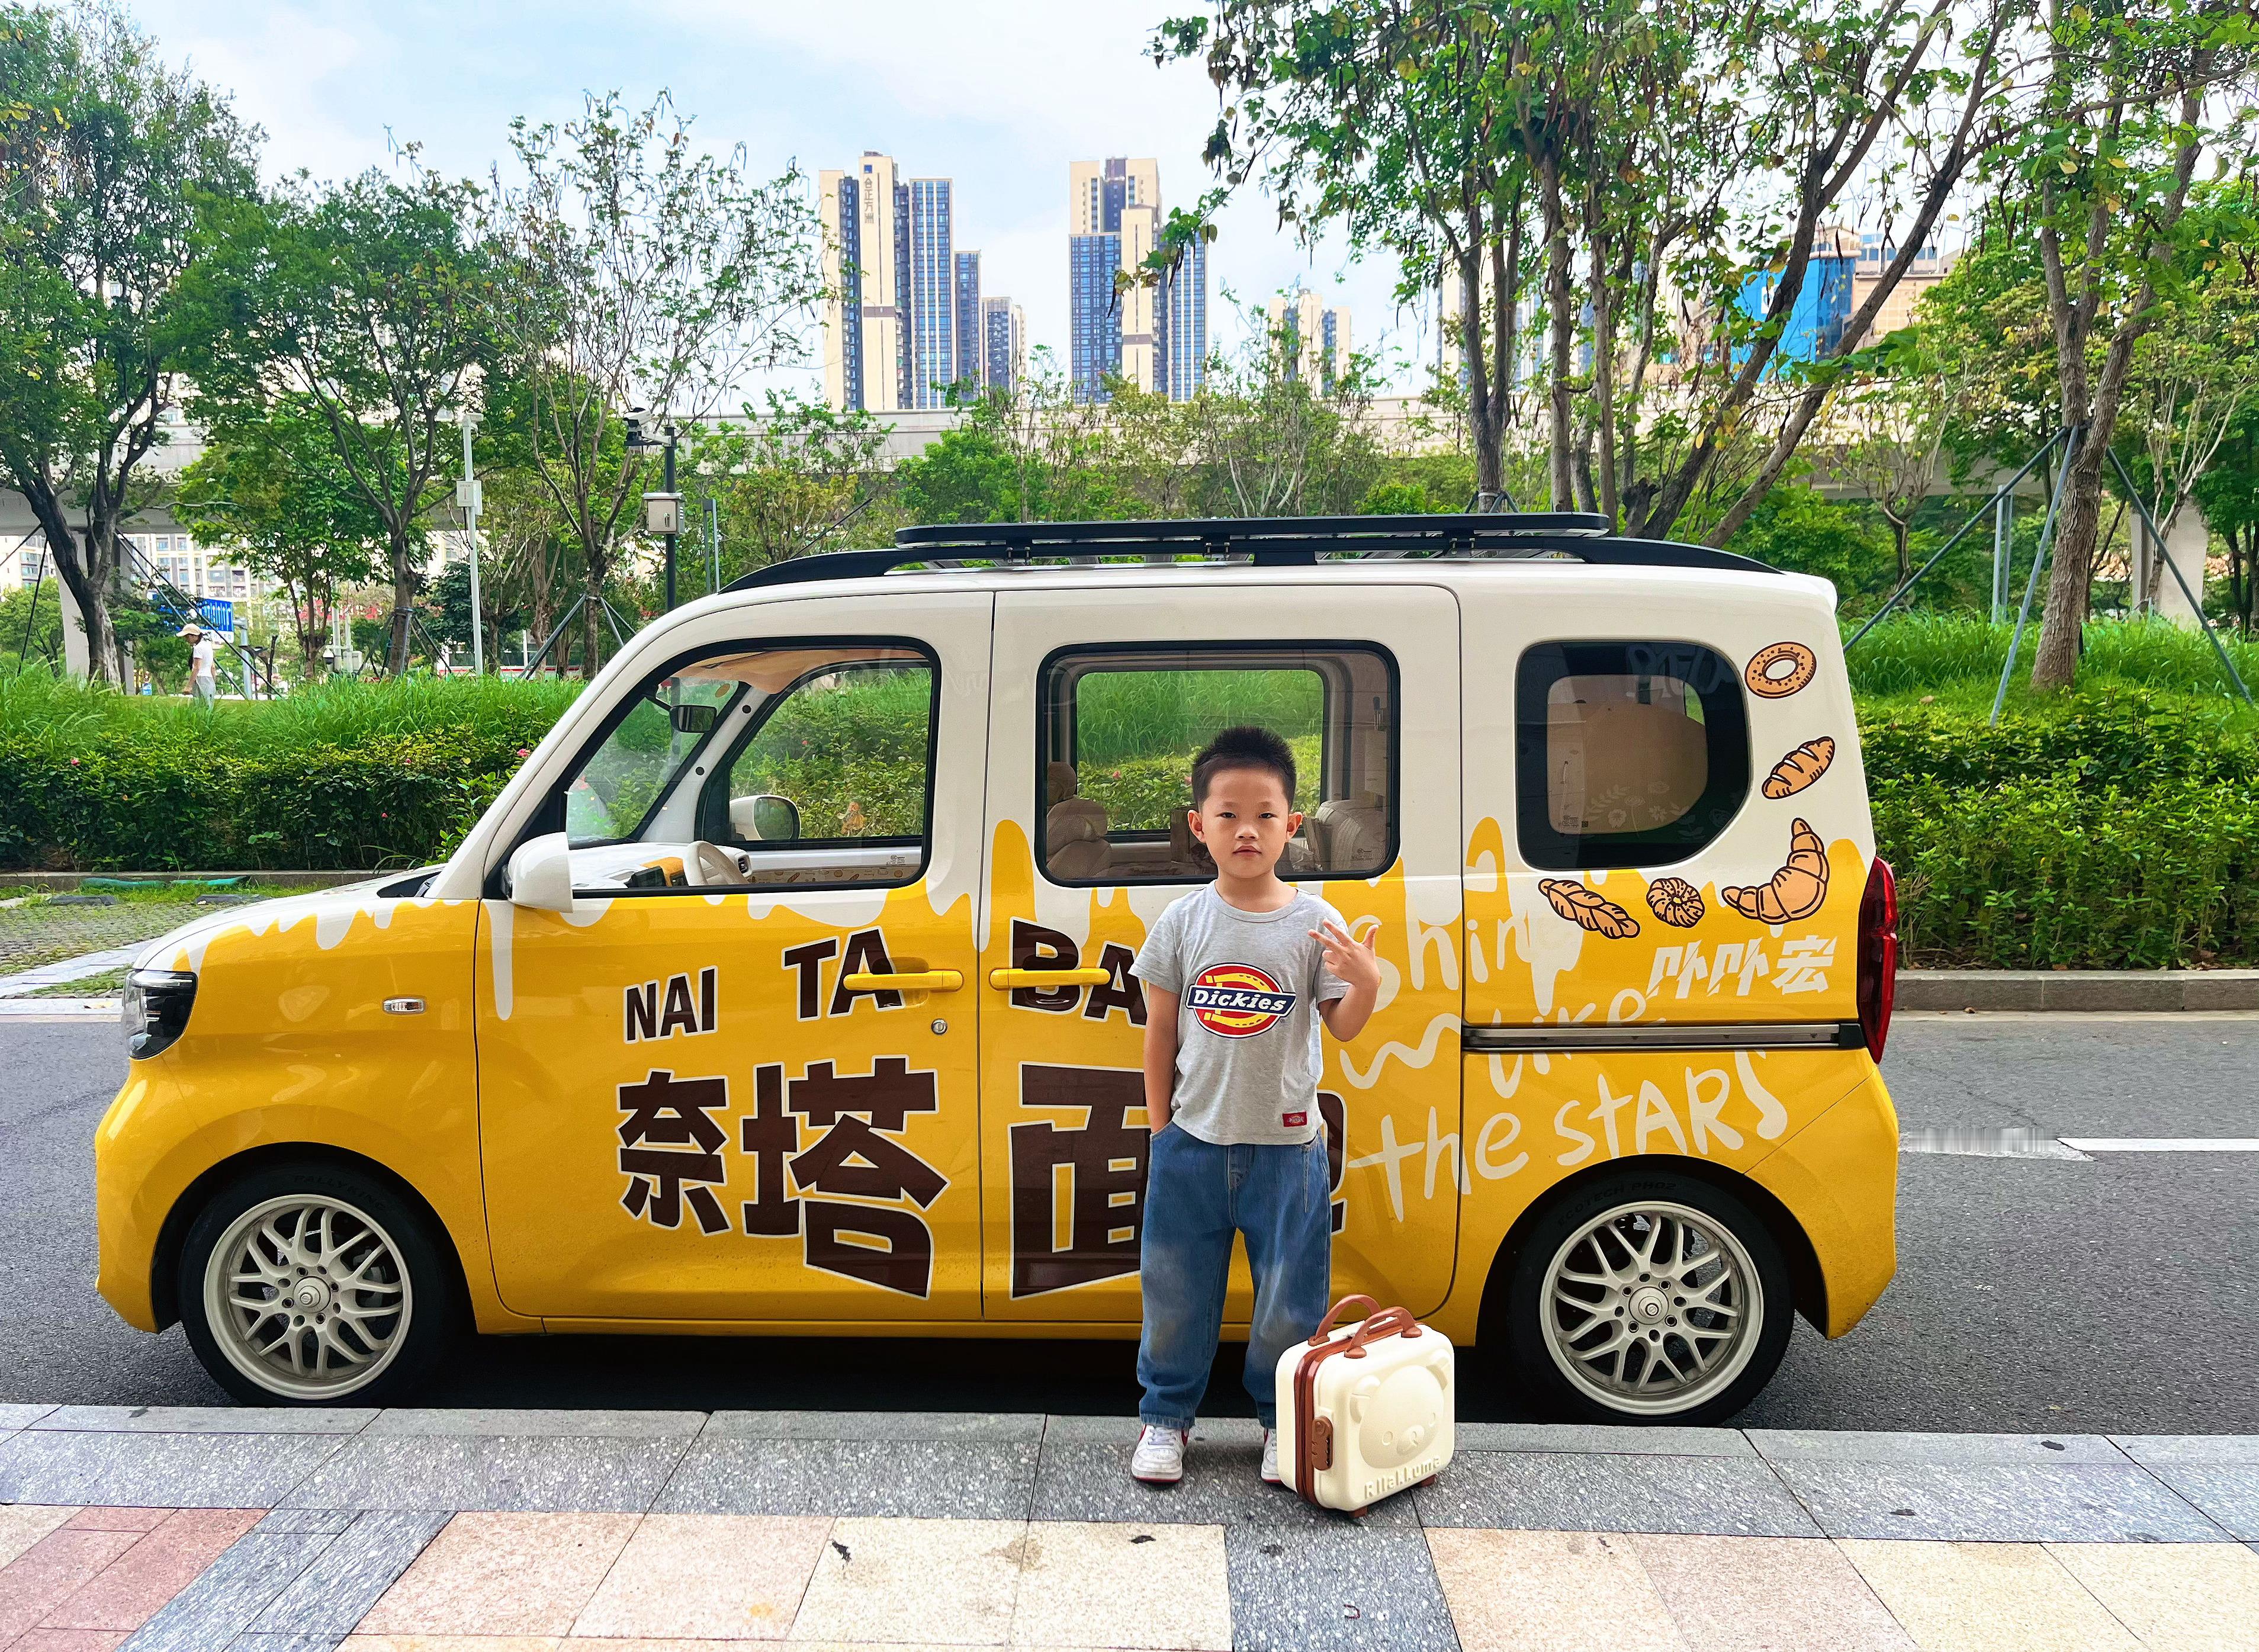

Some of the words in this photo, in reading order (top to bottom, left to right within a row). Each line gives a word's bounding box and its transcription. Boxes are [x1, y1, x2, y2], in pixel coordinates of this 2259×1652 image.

[625, 966, 717, 1043] NAI
[782, 926, 906, 1021] TA
[1193, 989, 1287, 1011] Dickies
[1347, 1106, 1529, 1222] the
